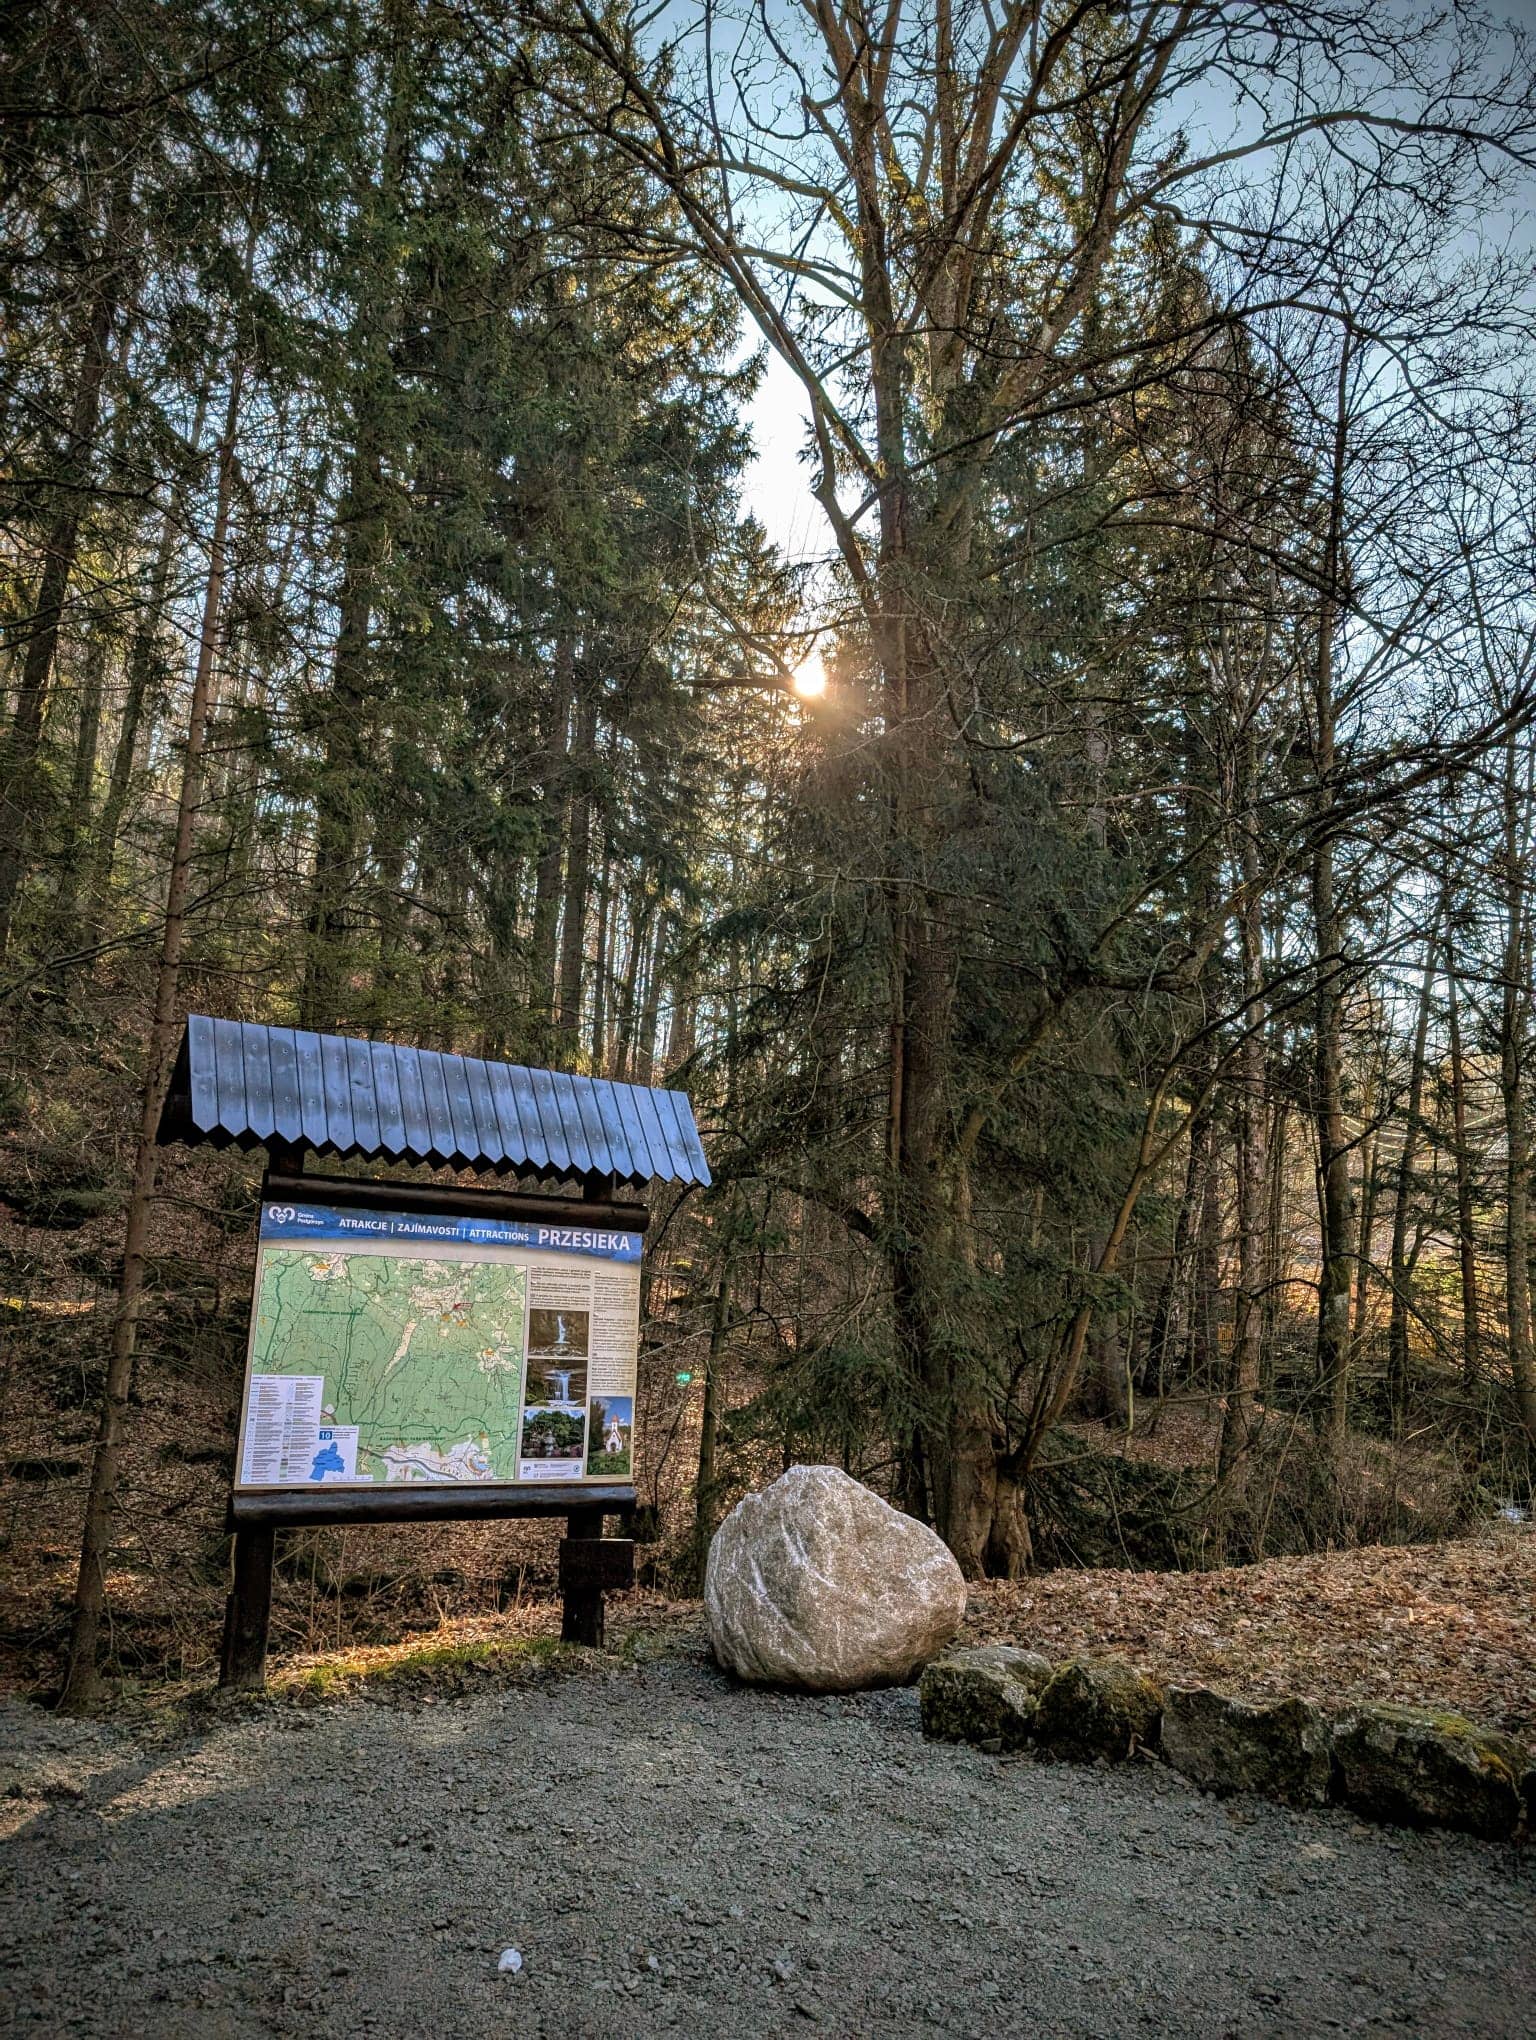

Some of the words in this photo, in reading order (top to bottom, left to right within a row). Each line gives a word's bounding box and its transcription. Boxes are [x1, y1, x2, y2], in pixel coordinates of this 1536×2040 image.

[339, 1218, 388, 1231] ATRAKCJE
[397, 1223, 459, 1236] ZAJÍMAVOSTI
[469, 1229, 530, 1241] ATTRACTIONS
[538, 1229, 630, 1250] PRZESIEKA
